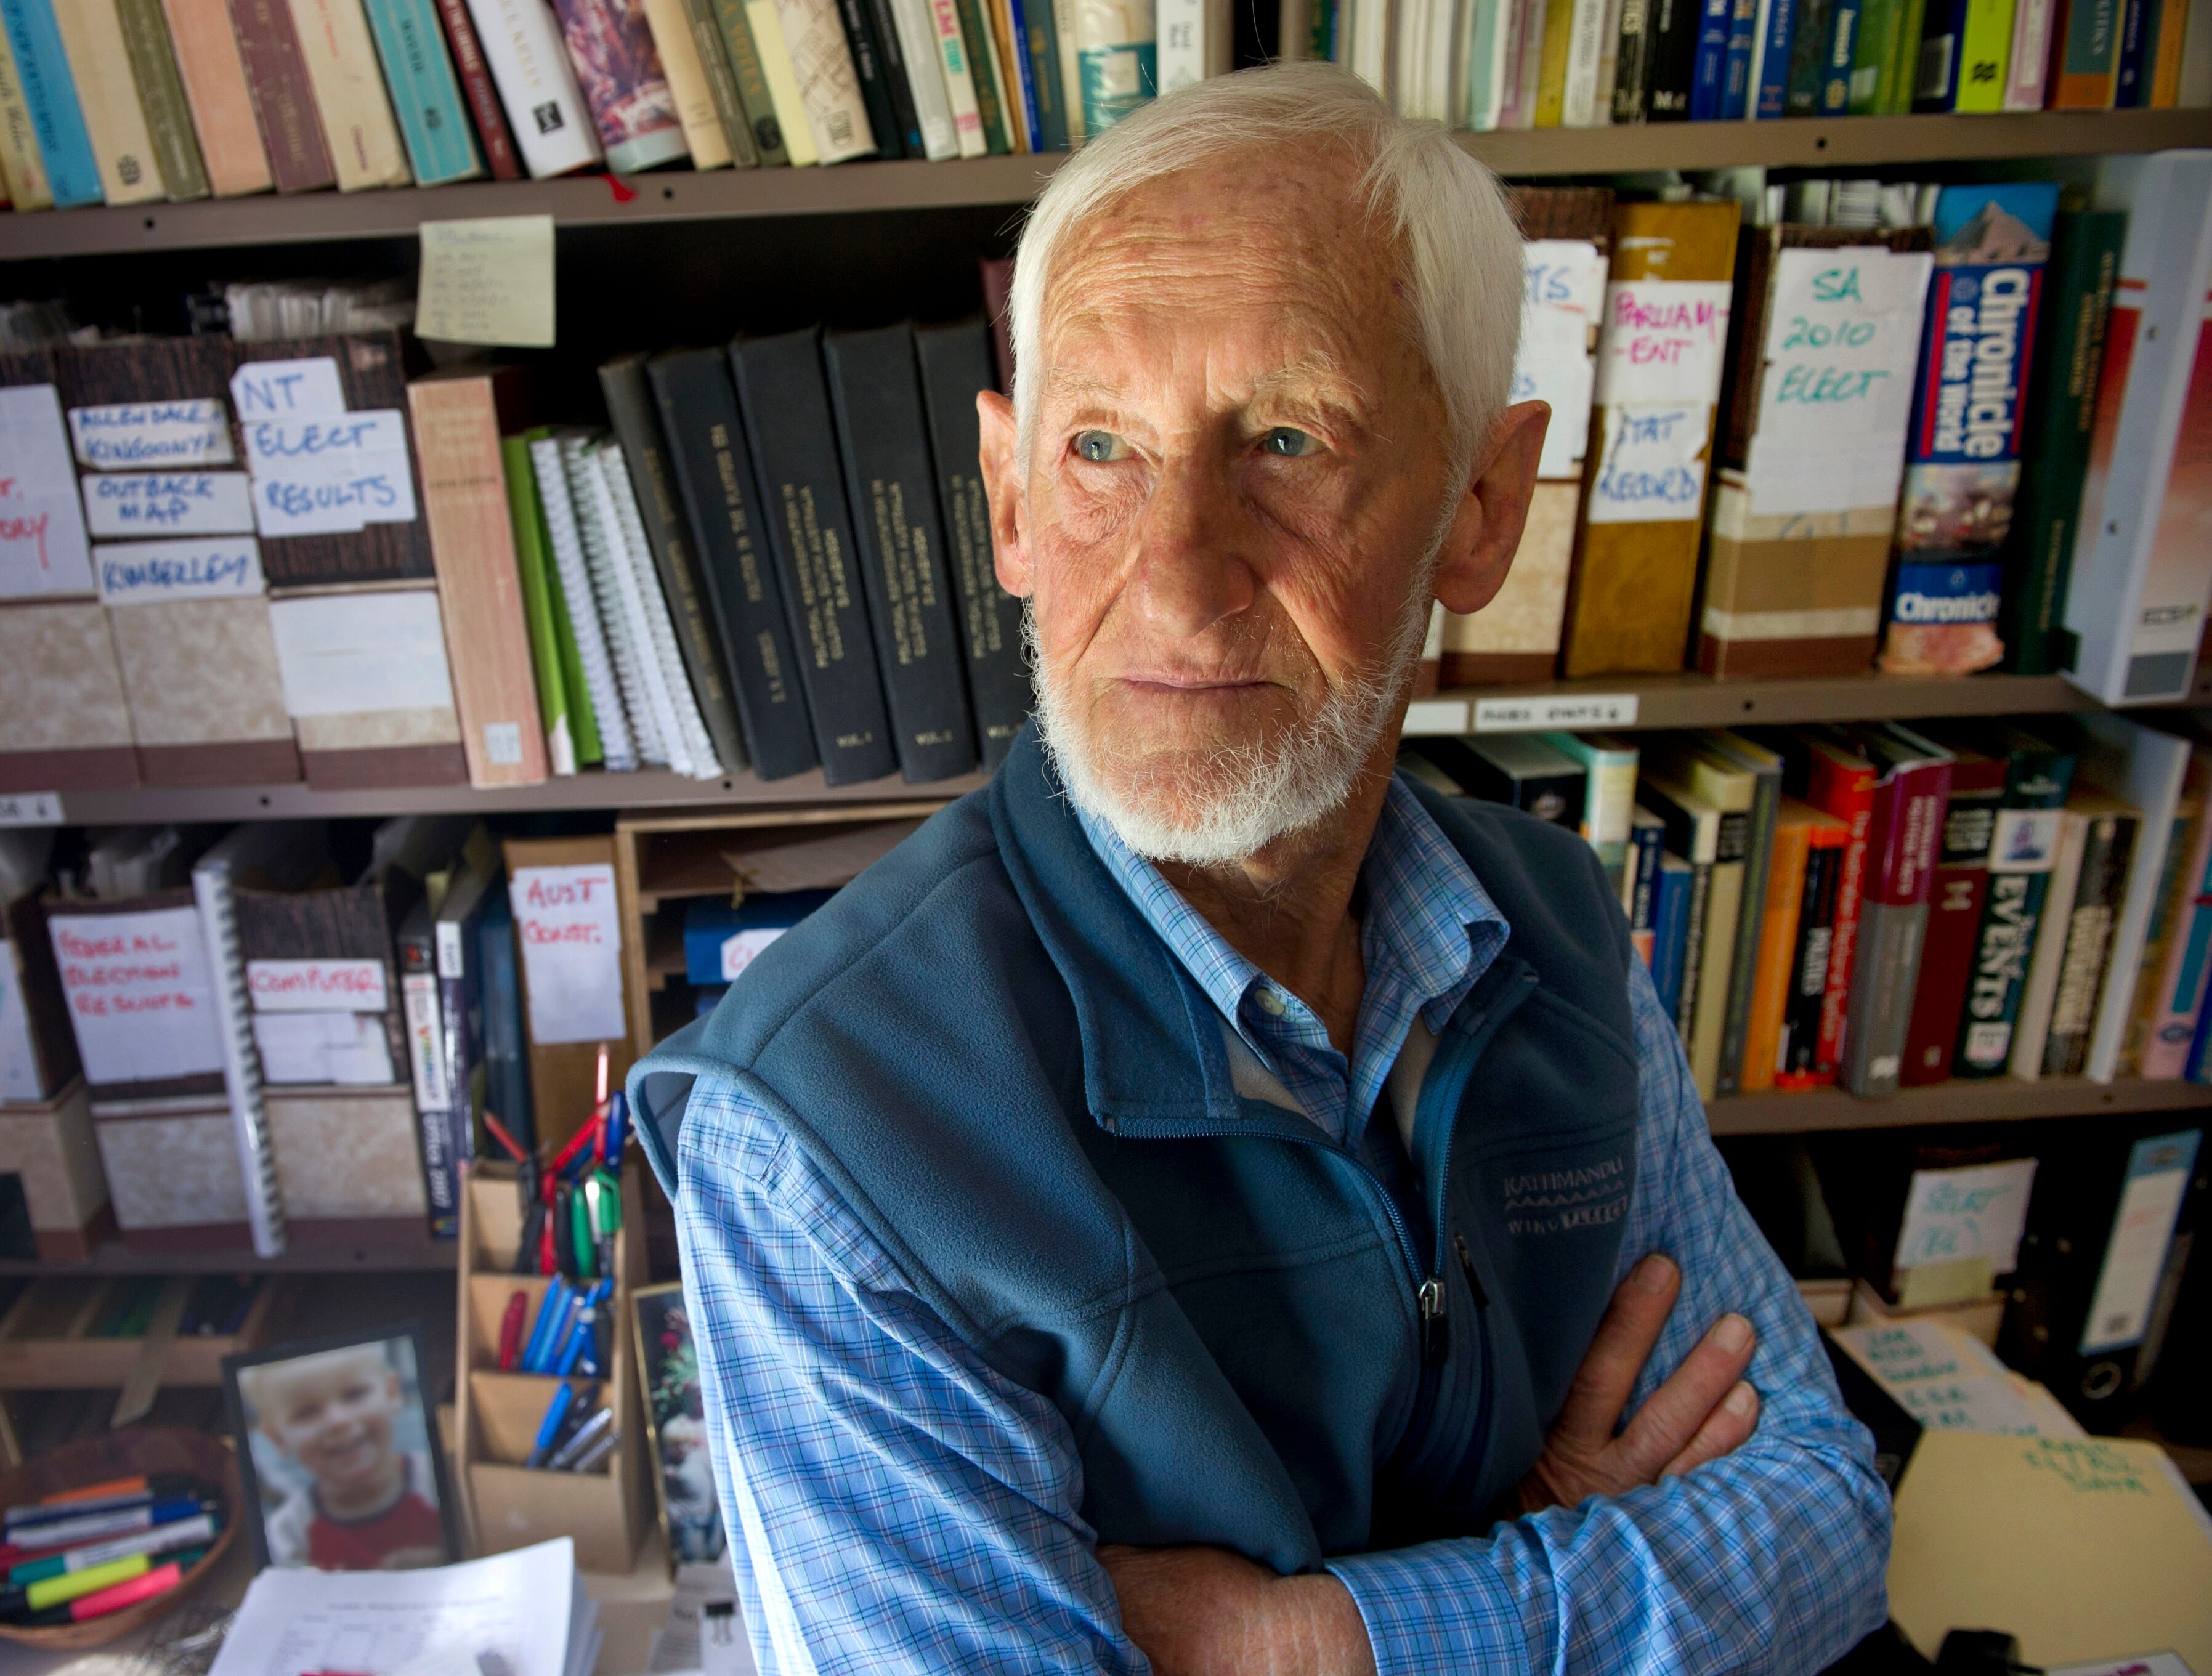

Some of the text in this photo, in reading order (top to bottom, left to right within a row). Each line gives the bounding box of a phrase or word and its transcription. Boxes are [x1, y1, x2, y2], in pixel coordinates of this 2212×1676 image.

[1813, 267, 1862, 304] SA
[1783, 316, 1876, 349] 2010
[1948, 306, 1977, 334] of
[1963, 268, 2031, 458] Chronicle
[241, 372, 304, 411] NT
[1776, 363, 1890, 403] ELECT
[255, 421, 378, 457] ELECT
[97, 475, 214, 498] OUTBACK
[266, 474, 396, 516] RESULTS
[119, 496, 189, 524] MAP
[527, 876, 609, 908] AUST
[1969, 875, 2029, 1019] EVENTS
[1504, 1157, 1624, 1197] KATHMANDU
